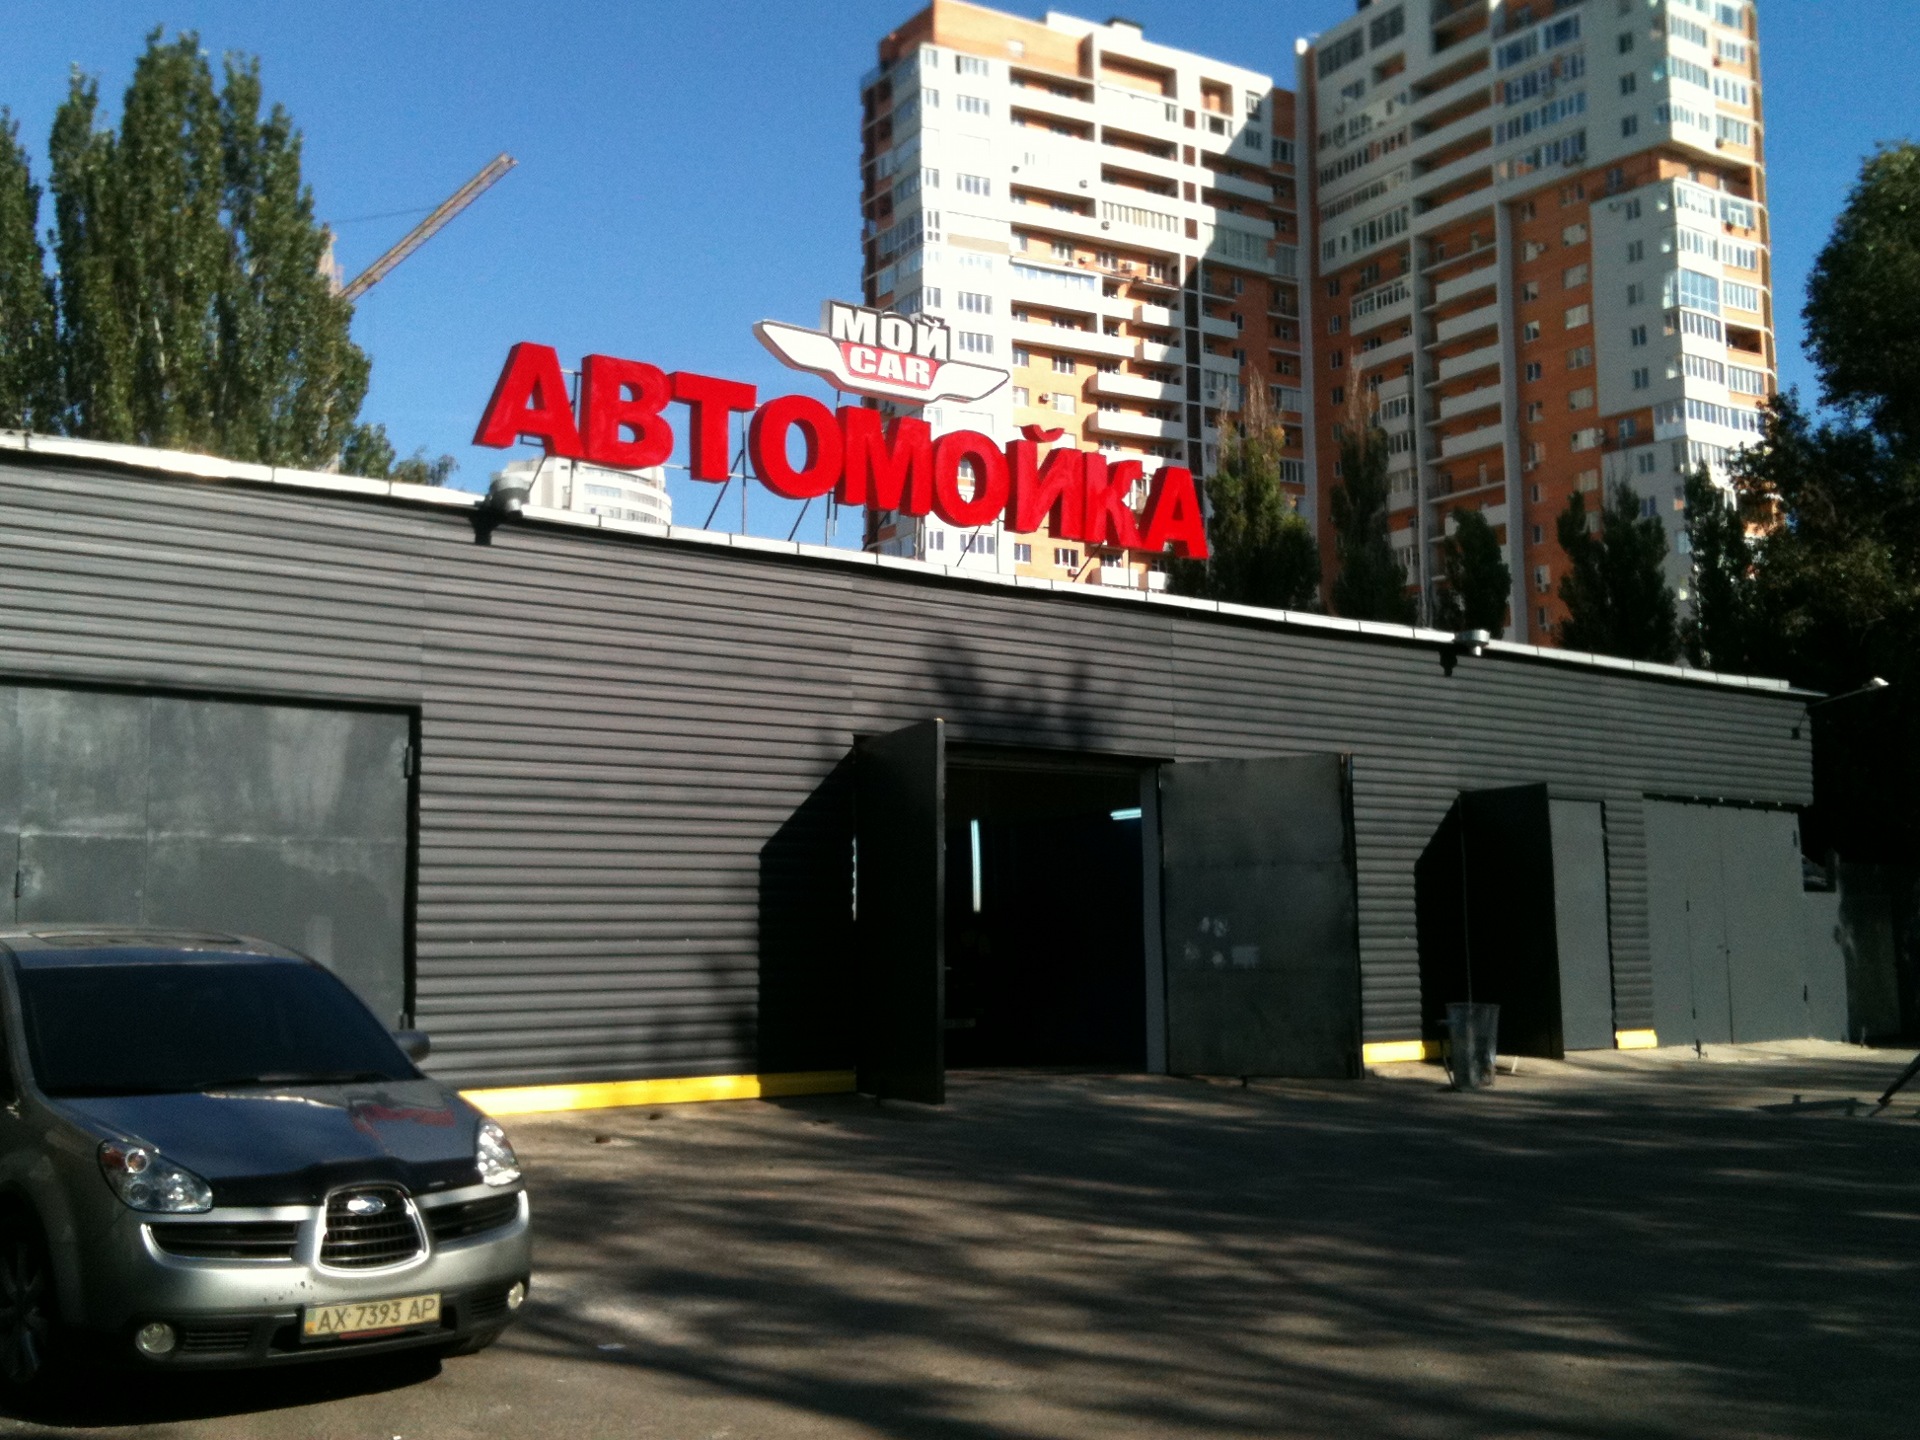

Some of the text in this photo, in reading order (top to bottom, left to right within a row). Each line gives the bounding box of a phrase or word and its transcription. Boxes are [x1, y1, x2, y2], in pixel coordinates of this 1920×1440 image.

[831, 302, 949, 362] МОЙ
[850, 346, 930, 386] CAR
[473, 341, 1209, 560] АВТОМОЙКА
[356, 1303, 401, 1326] 7393
